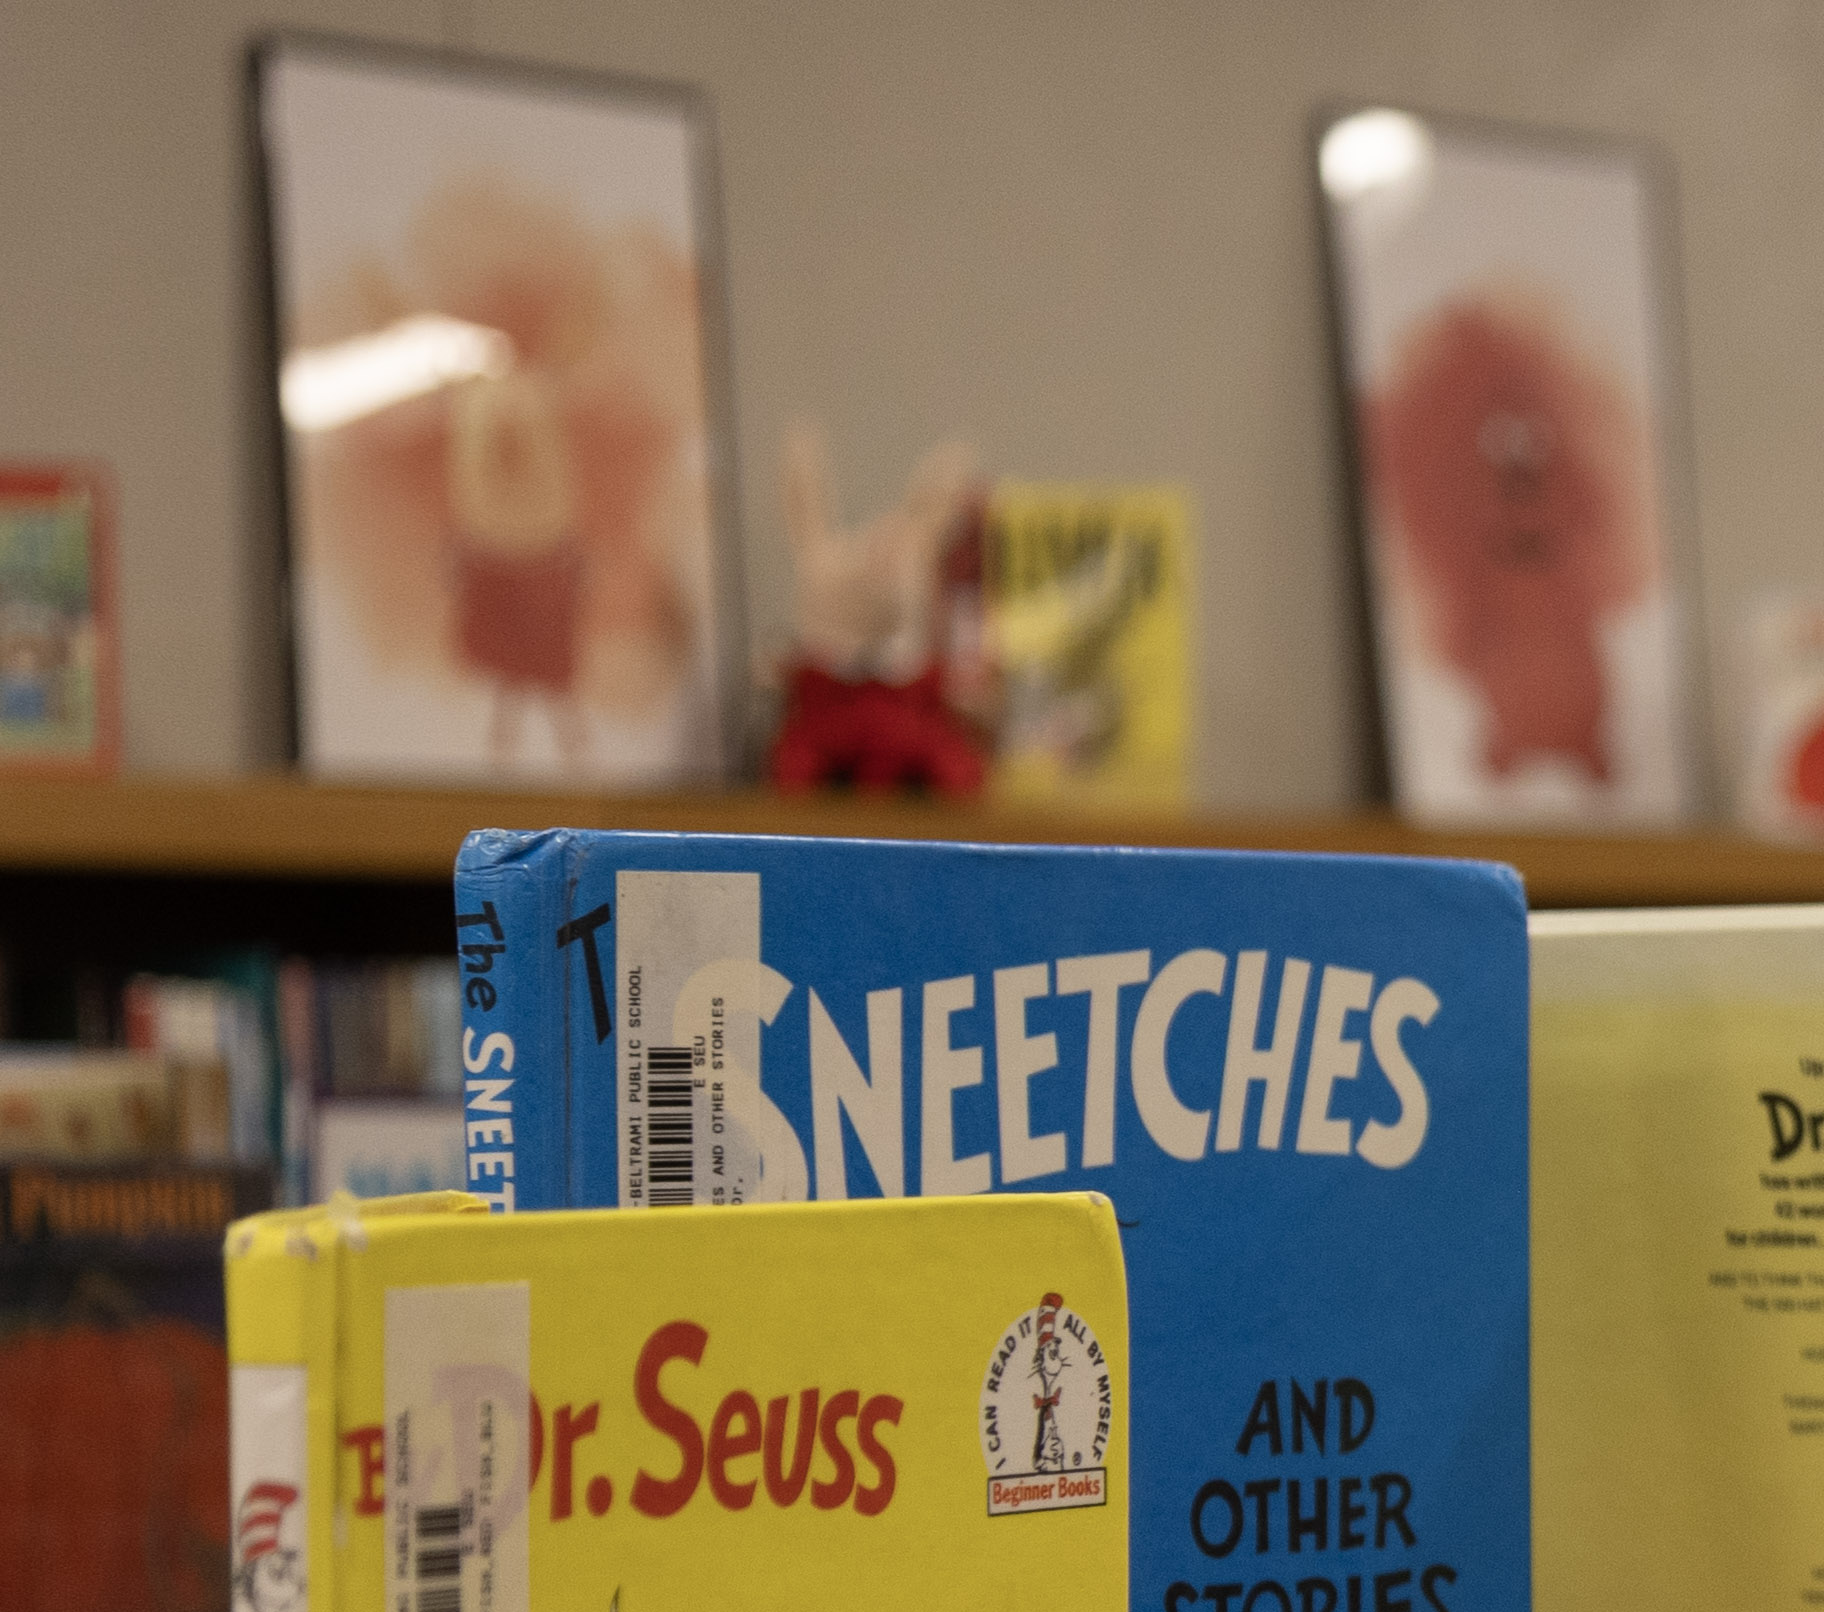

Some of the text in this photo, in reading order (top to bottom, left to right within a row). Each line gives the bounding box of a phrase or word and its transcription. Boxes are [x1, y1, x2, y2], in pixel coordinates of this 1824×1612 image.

[455, 901, 505, 1013] The
[628, 966, 642, 1029] SCHOOL
[693, 1035, 706, 1067] SEU
[712, 997, 725, 1070] STORIES
[628, 1040, 642, 1104] PUBLIC
[672, 948, 1441, 1203] SNEETCHES
[712, 1081, 725, 1134] OTHER
[712, 1144, 725, 1176] AND
[1018, 1316, 1032, 1340] IT
[1063, 1313, 1088, 1344] ALL
[1087, 1341, 1106, 1368] BY
[987, 1335, 1016, 1393] READ
[629, 1319, 906, 1519] Seuss
[985, 1405, 1001, 1452] CAN
[1092, 1373, 1112, 1462] MYSELF
[1235, 1377, 1377, 1459] AND
[992, 1474, 1101, 1508] Beginner Books
[1189, 1472, 1417, 1559] OTHER
